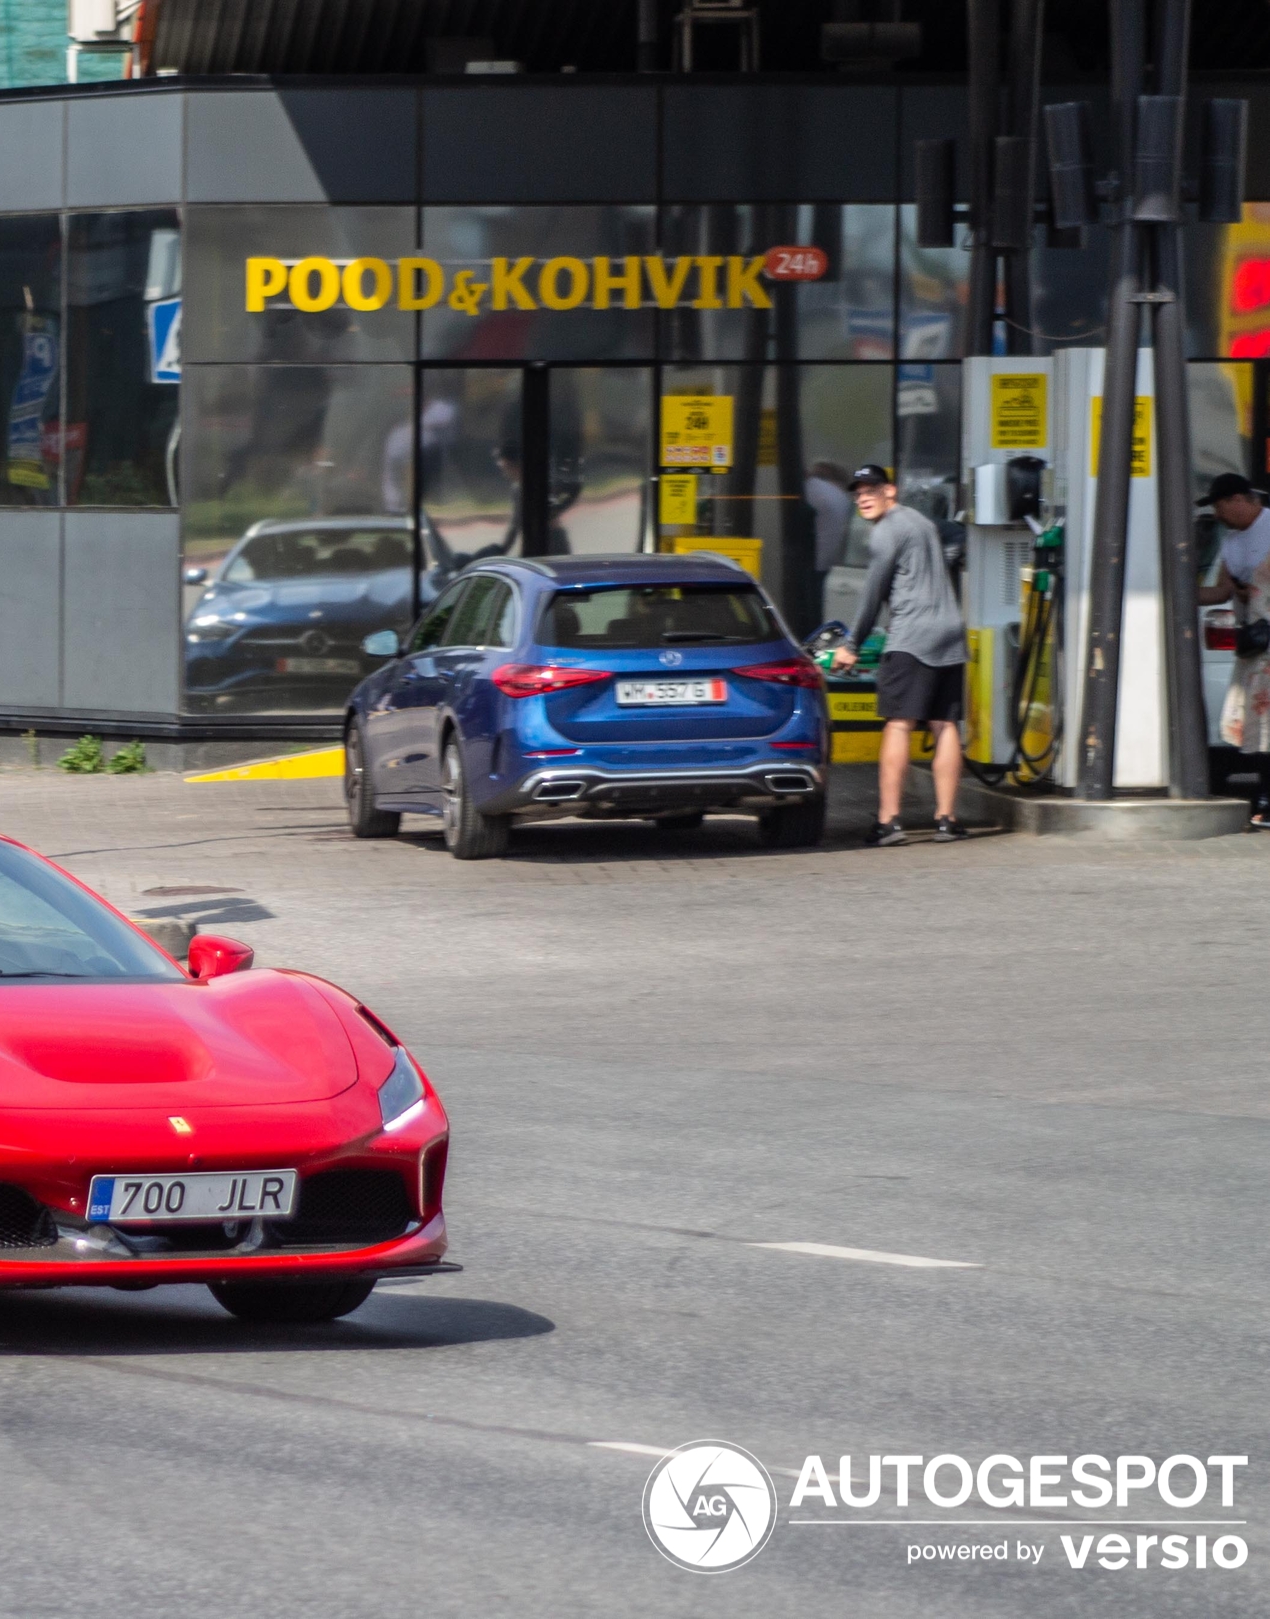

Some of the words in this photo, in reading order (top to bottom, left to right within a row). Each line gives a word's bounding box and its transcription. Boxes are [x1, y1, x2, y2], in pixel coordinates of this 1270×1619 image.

[775, 253, 819, 275] 24h
[655, 682, 688, 698] 557
[834, 702, 877, 711] OLERE
[90, 1204, 110, 1215] EST
[118, 1180, 186, 1215] 700
[216, 1177, 285, 1211] JLR
